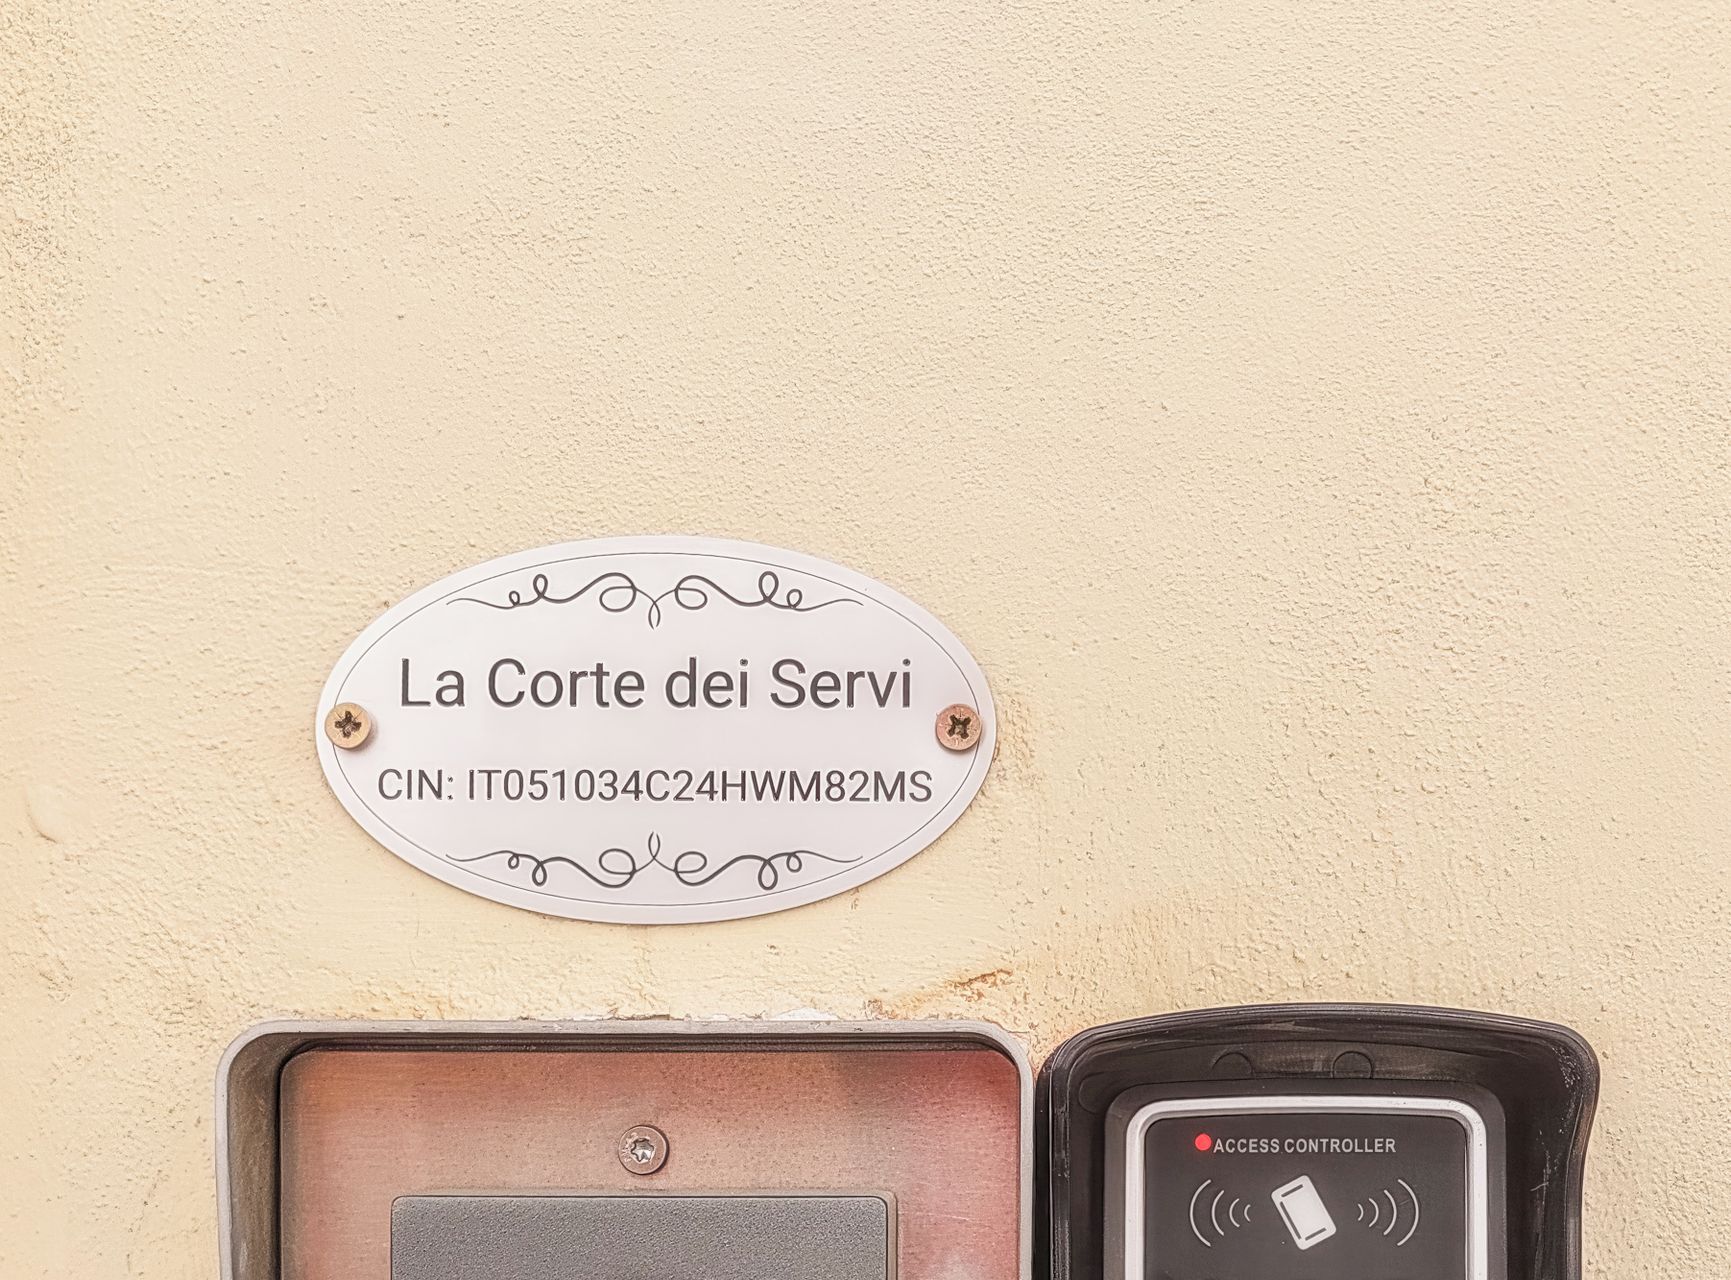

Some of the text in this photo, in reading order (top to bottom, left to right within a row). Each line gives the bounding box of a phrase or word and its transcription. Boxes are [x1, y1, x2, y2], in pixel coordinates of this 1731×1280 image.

[400, 656, 912, 709] La Corte dei Servi
[377, 768, 933, 803] CIN: IT051034C24HWM82MS
[1212, 1137, 1397, 1154] ACCESS CONTROLLER
